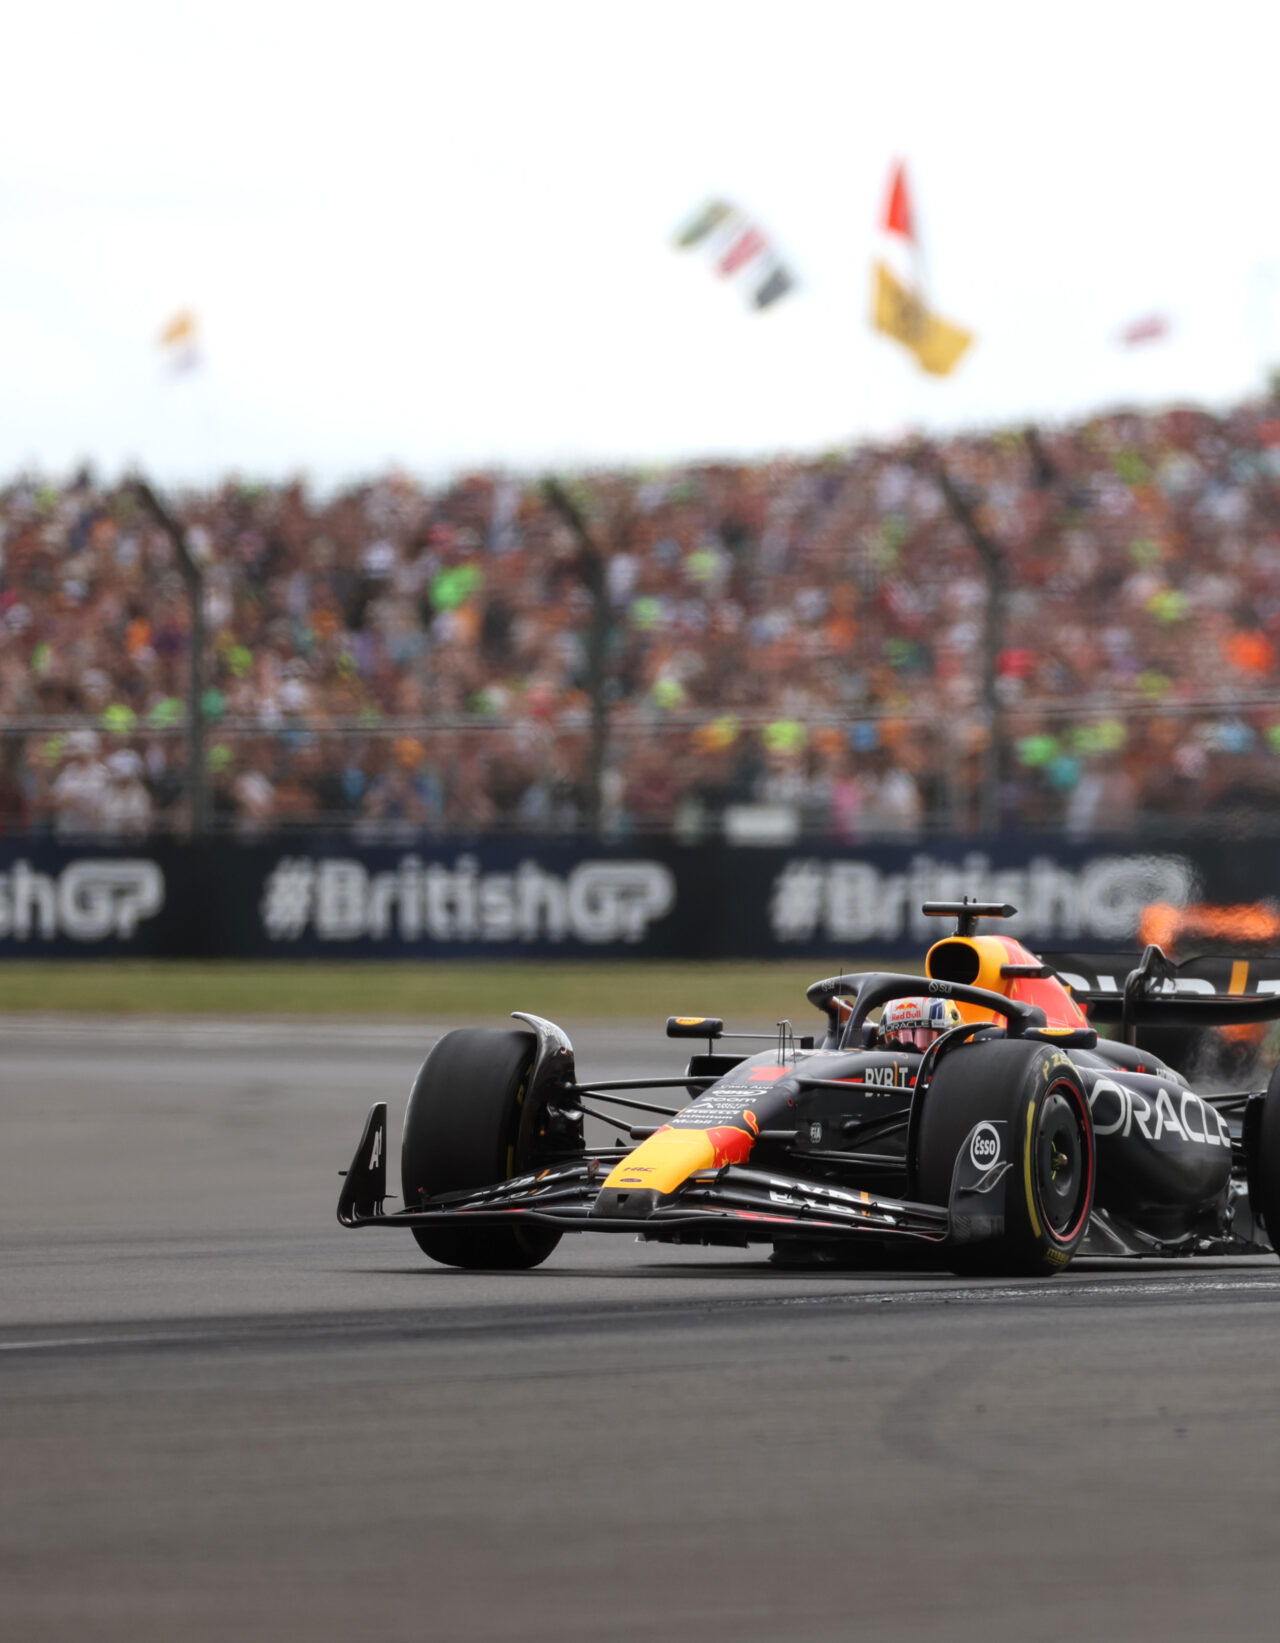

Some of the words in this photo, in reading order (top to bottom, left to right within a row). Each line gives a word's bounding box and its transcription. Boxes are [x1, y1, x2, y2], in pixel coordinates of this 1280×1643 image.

[262, 855, 674, 941] #BritishGP
[906, 1010, 921, 1018] Bull
[885, 1021, 930, 1033] ORACLE
[1089, 1079, 1231, 1148] ORACLE
[974, 1136, 996, 1156] Esso
